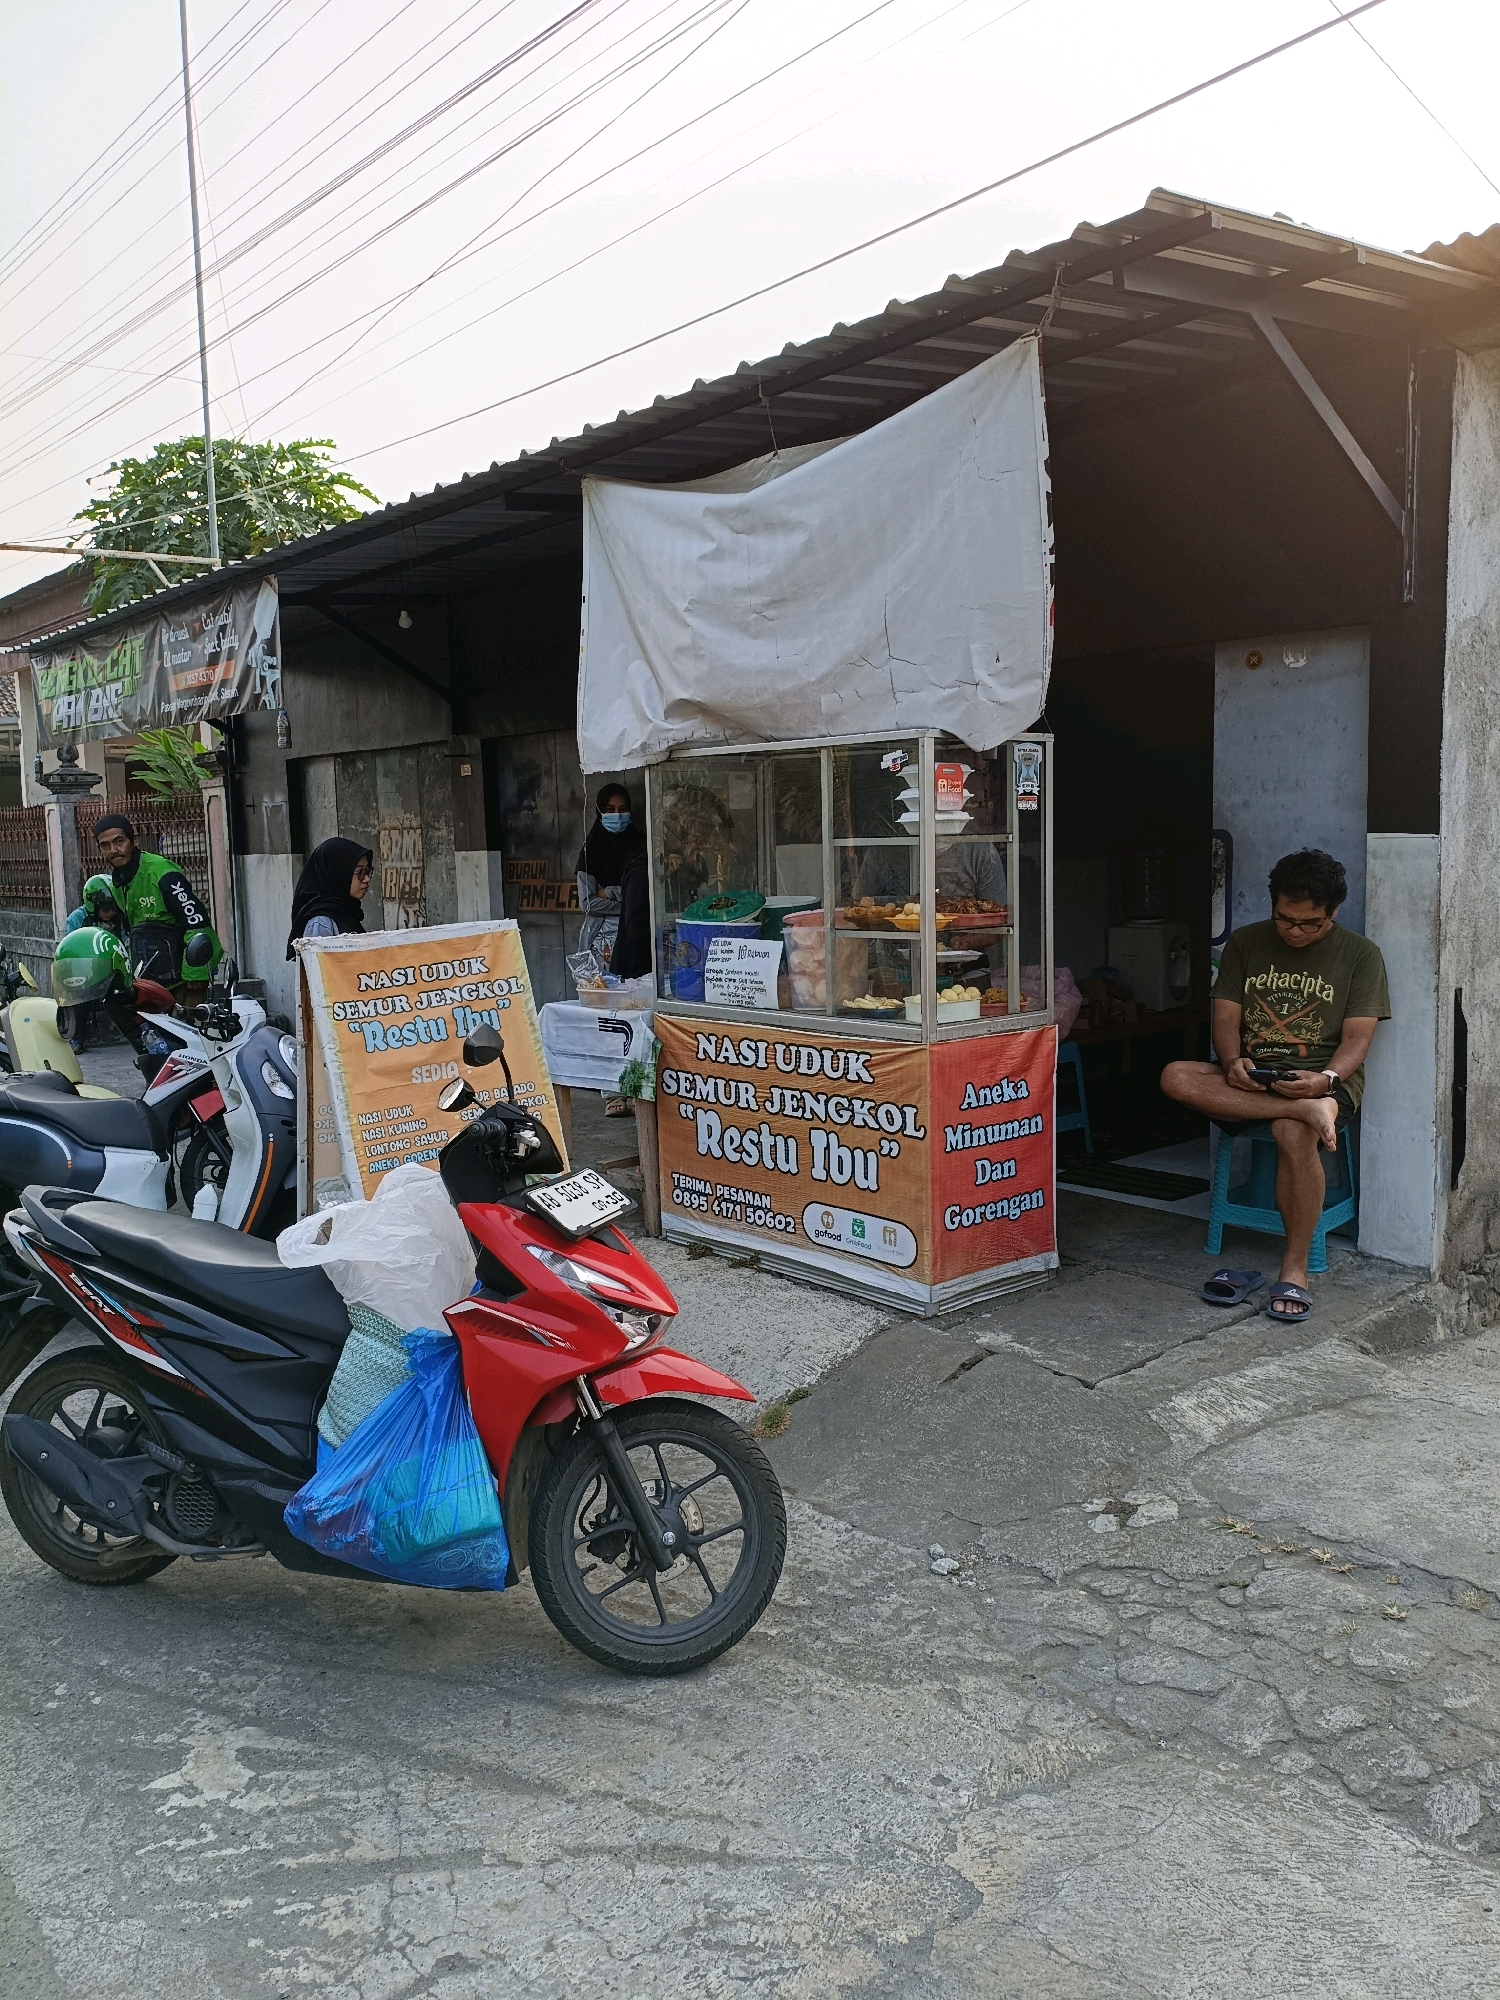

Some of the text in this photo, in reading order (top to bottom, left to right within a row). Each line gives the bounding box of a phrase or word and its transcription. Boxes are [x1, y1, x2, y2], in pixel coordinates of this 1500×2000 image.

[507, 861, 547, 880] BURUH
[171, 881, 203, 925] gojek
[358, 956, 489, 991] NASI UDUK
[1244, 964, 1334, 1005] rekacipta
[333, 977, 524, 1021] SEMUR JENGKOL
[178, 1053, 208, 1064] HONDA
[411, 1061, 459, 1085] SEDIA
[695, 1032, 875, 1084] NASI UDUK
[493, 1082, 535, 1099] BAADO
[662, 1067, 927, 1140] SEMUR JENGKOL
[959, 1076, 1030, 1110] Aneka
[358, 1105, 414, 1126] NASI UDUK
[362, 1119, 427, 1143] NASI KUNING
[365, 1131, 449, 1158] LONTONG SAYUR
[944, 1113, 1044, 1153] Minuman
[369, 1157, 401, 1174] ANEKA
[974, 1156, 1017, 1186] Dan
[537, 1172, 604, 1210] AB 5038 SP
[671, 1171, 771, 1209] TERIMA PESANAN
[672, 1188, 796, 1234] 0895 4171 50602
[944, 1188, 1045, 1232] Gorengan
[814, 1229, 842, 1241] gofood
